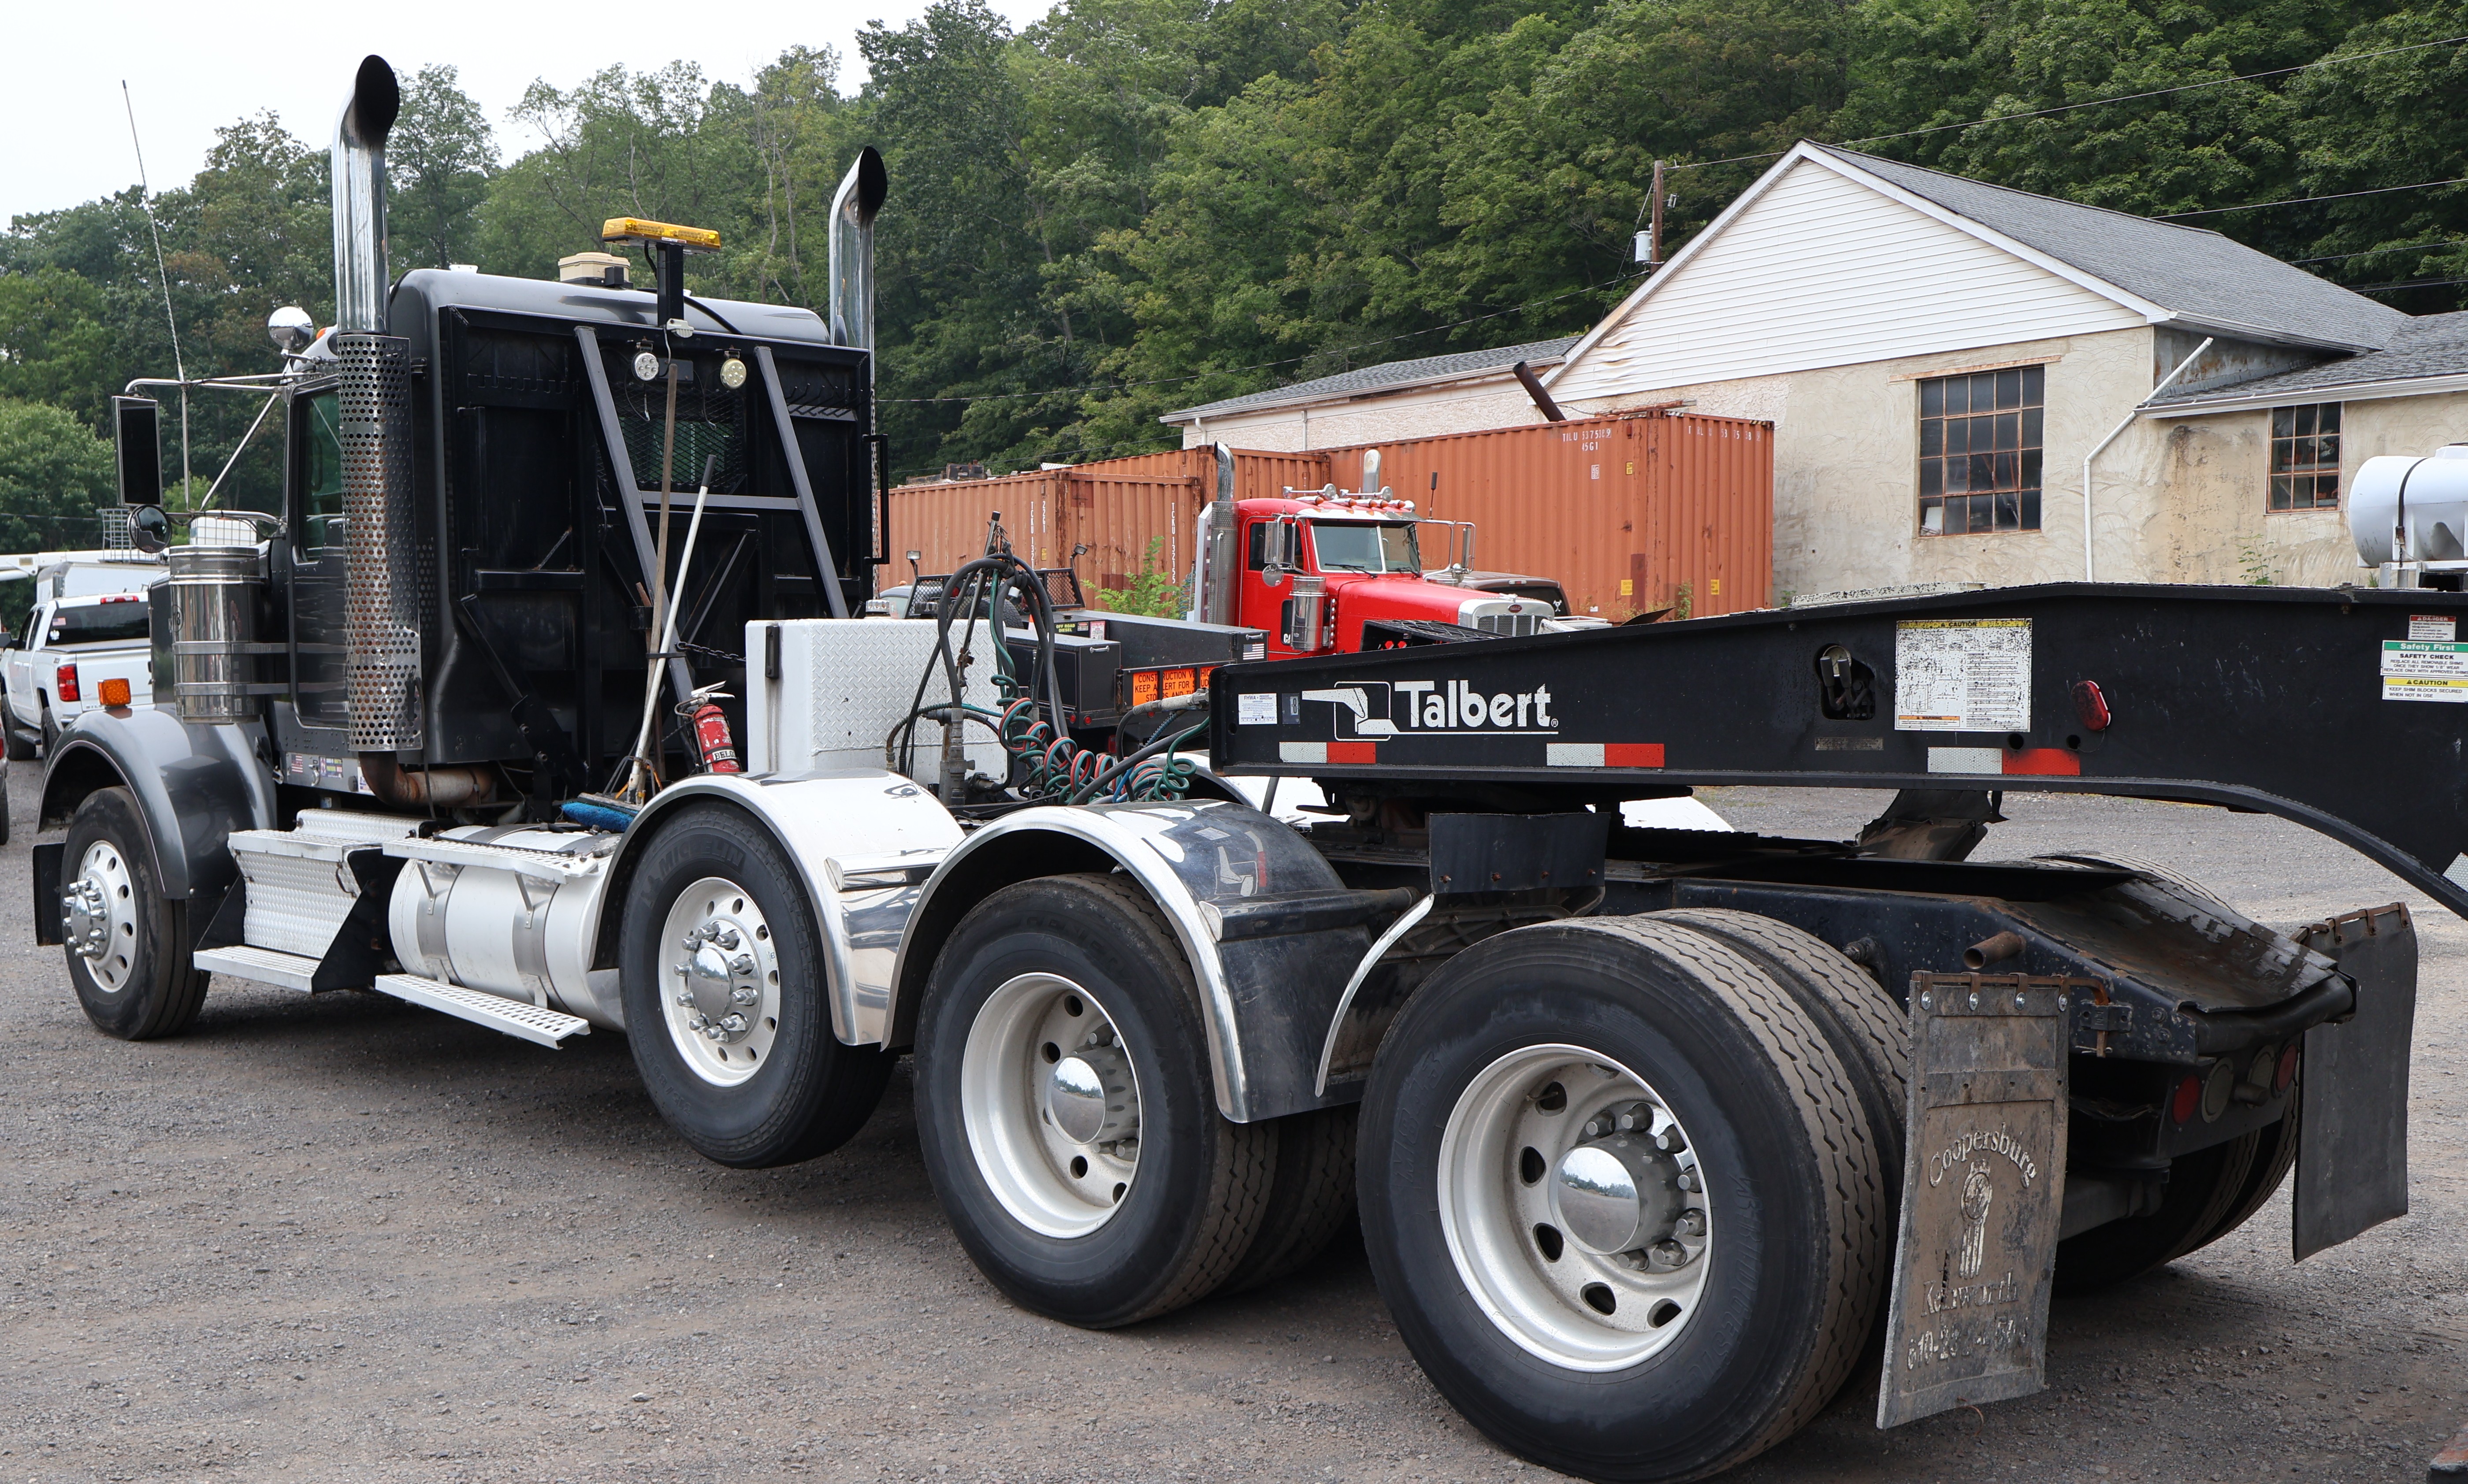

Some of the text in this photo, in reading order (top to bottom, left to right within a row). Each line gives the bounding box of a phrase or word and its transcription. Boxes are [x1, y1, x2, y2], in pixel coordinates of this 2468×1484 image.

[1135, 684, 1150, 693] KEEP
[1394, 680, 1551, 728] Talbert
[658, 838, 744, 875] MICHELIN
[1929, 1121, 2037, 1188] Coopersburg
[1921, 1267, 2019, 1317] Kenworth
